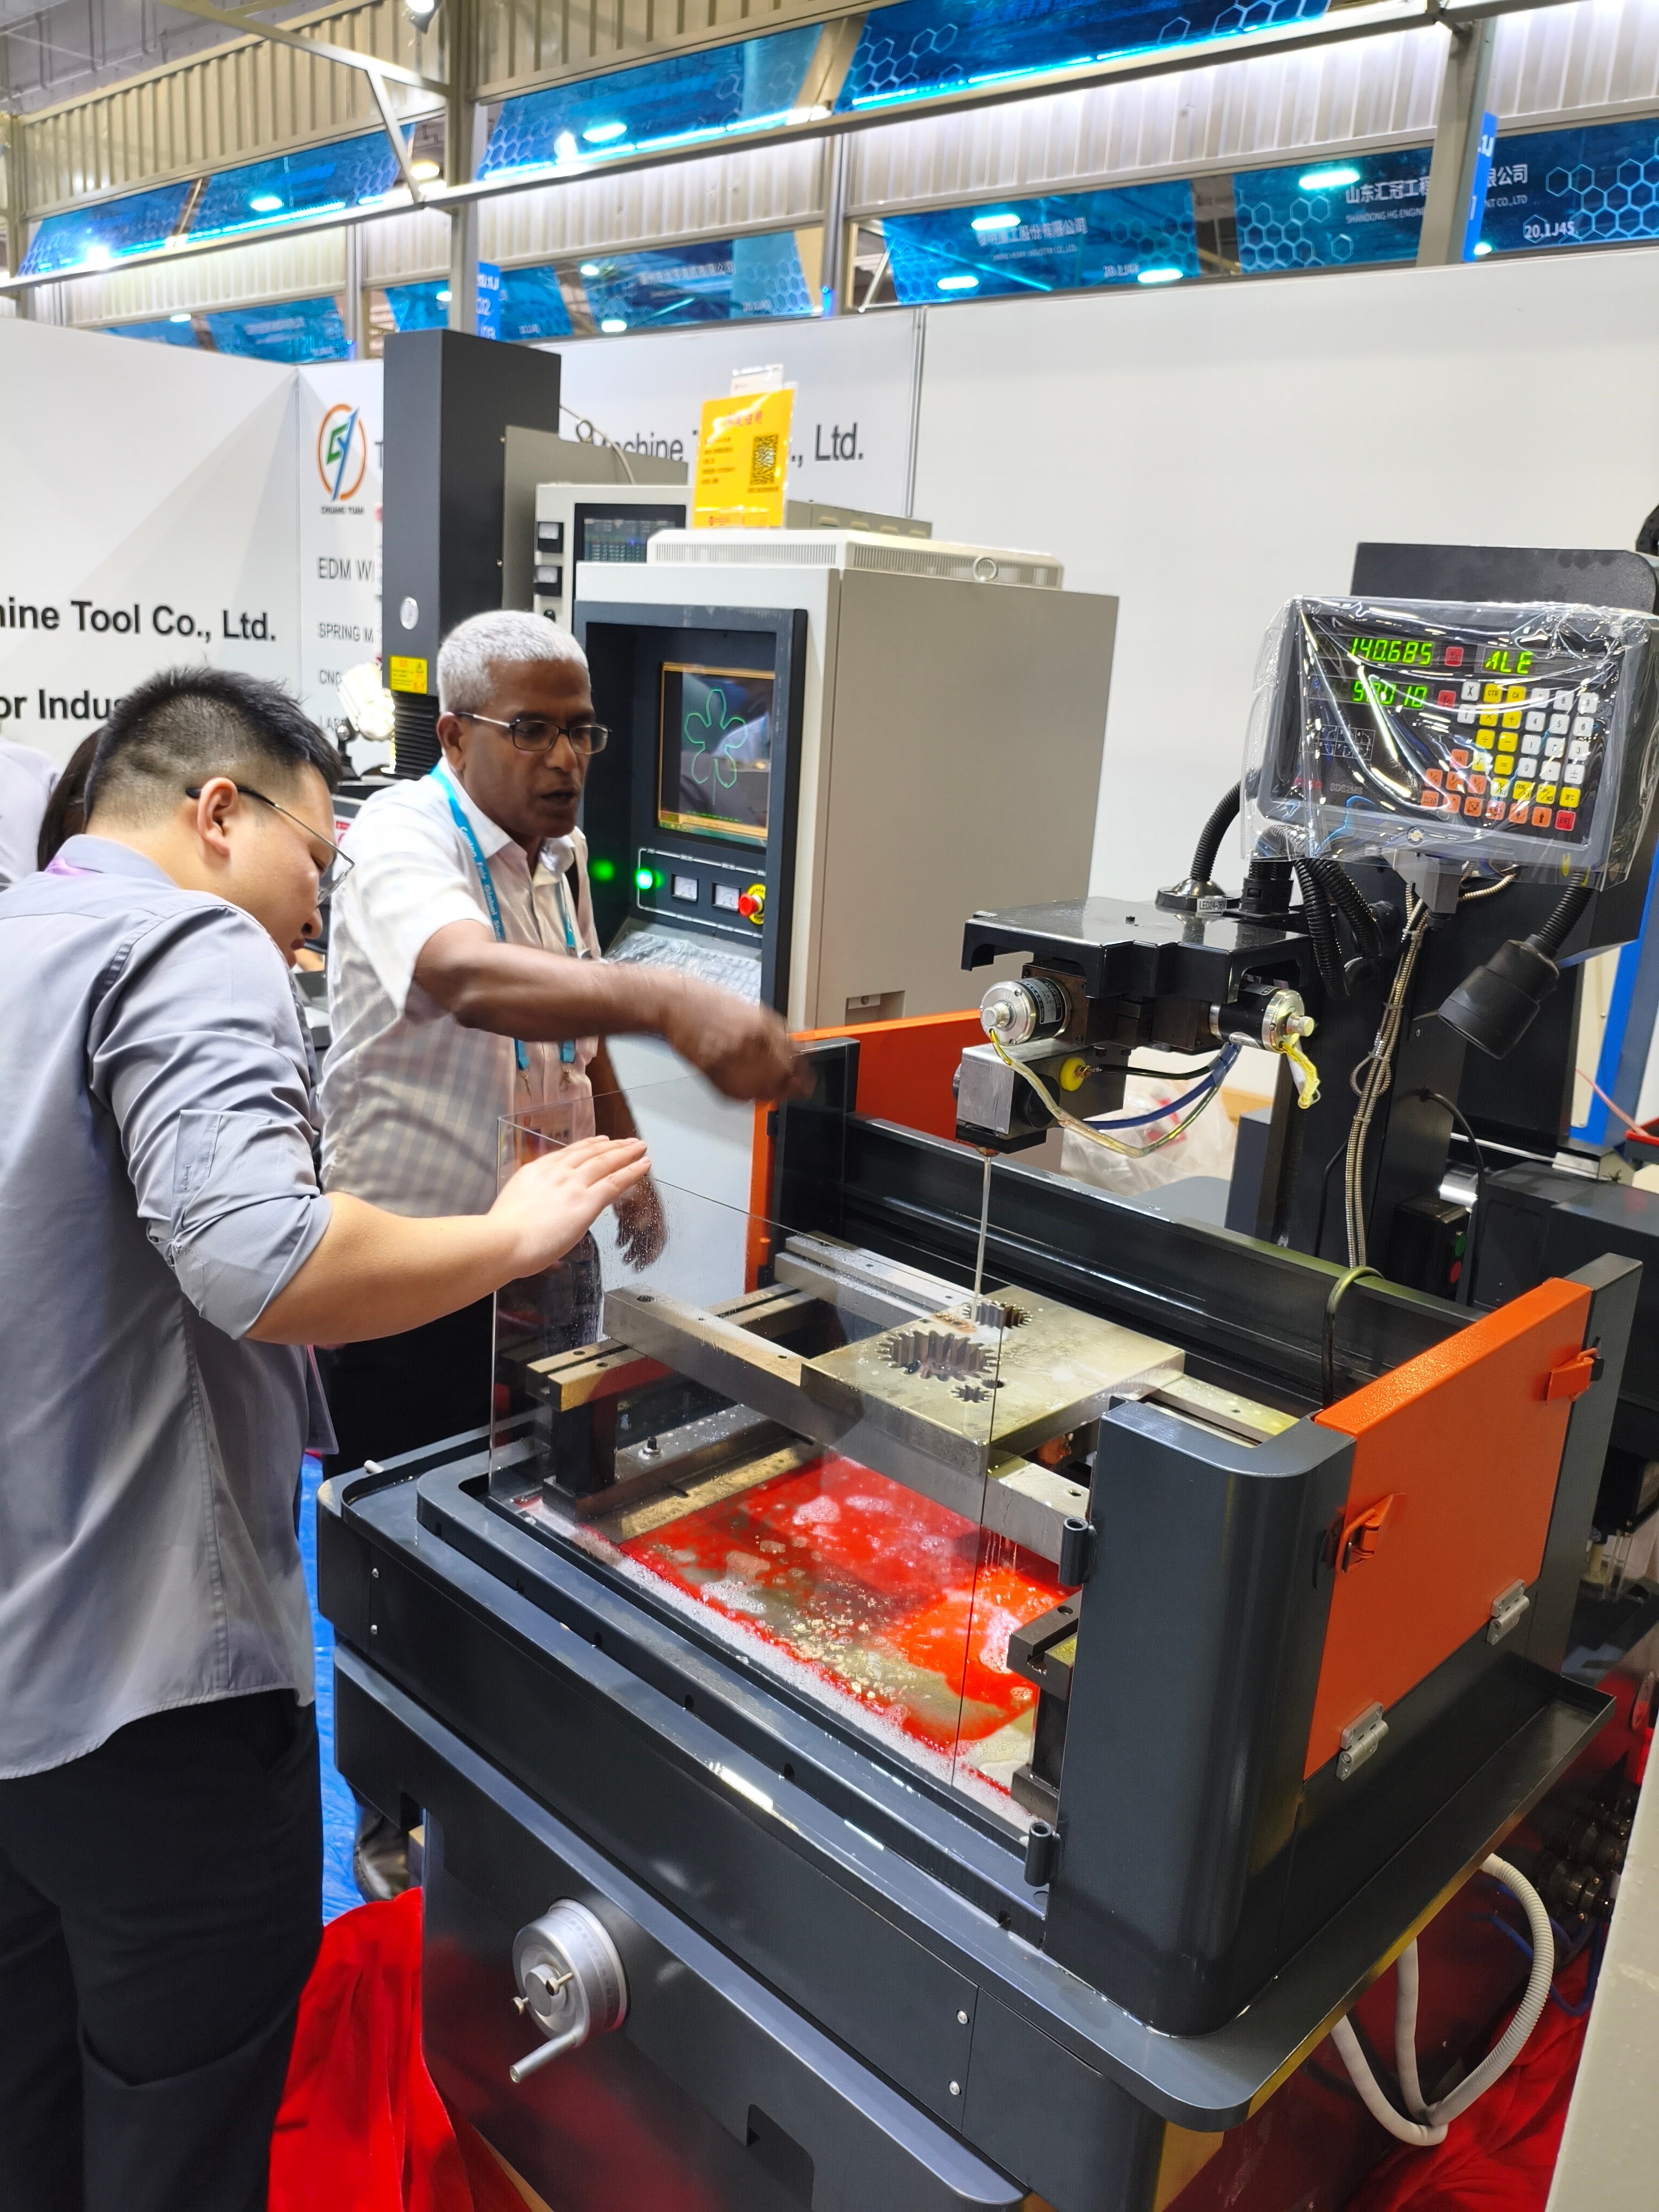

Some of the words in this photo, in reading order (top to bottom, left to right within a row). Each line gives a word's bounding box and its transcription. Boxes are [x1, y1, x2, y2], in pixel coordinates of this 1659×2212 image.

[814, 422, 864, 462] Ltd.
[319, 557, 351, 579] EDM
[71, 601, 140, 633] Tool
[152, 605, 211, 643] Co.,
[223, 610, 276, 641] Ltd.
[319, 623, 361, 642] SPRING
[1423, 796, 1437, 804] ZERO
